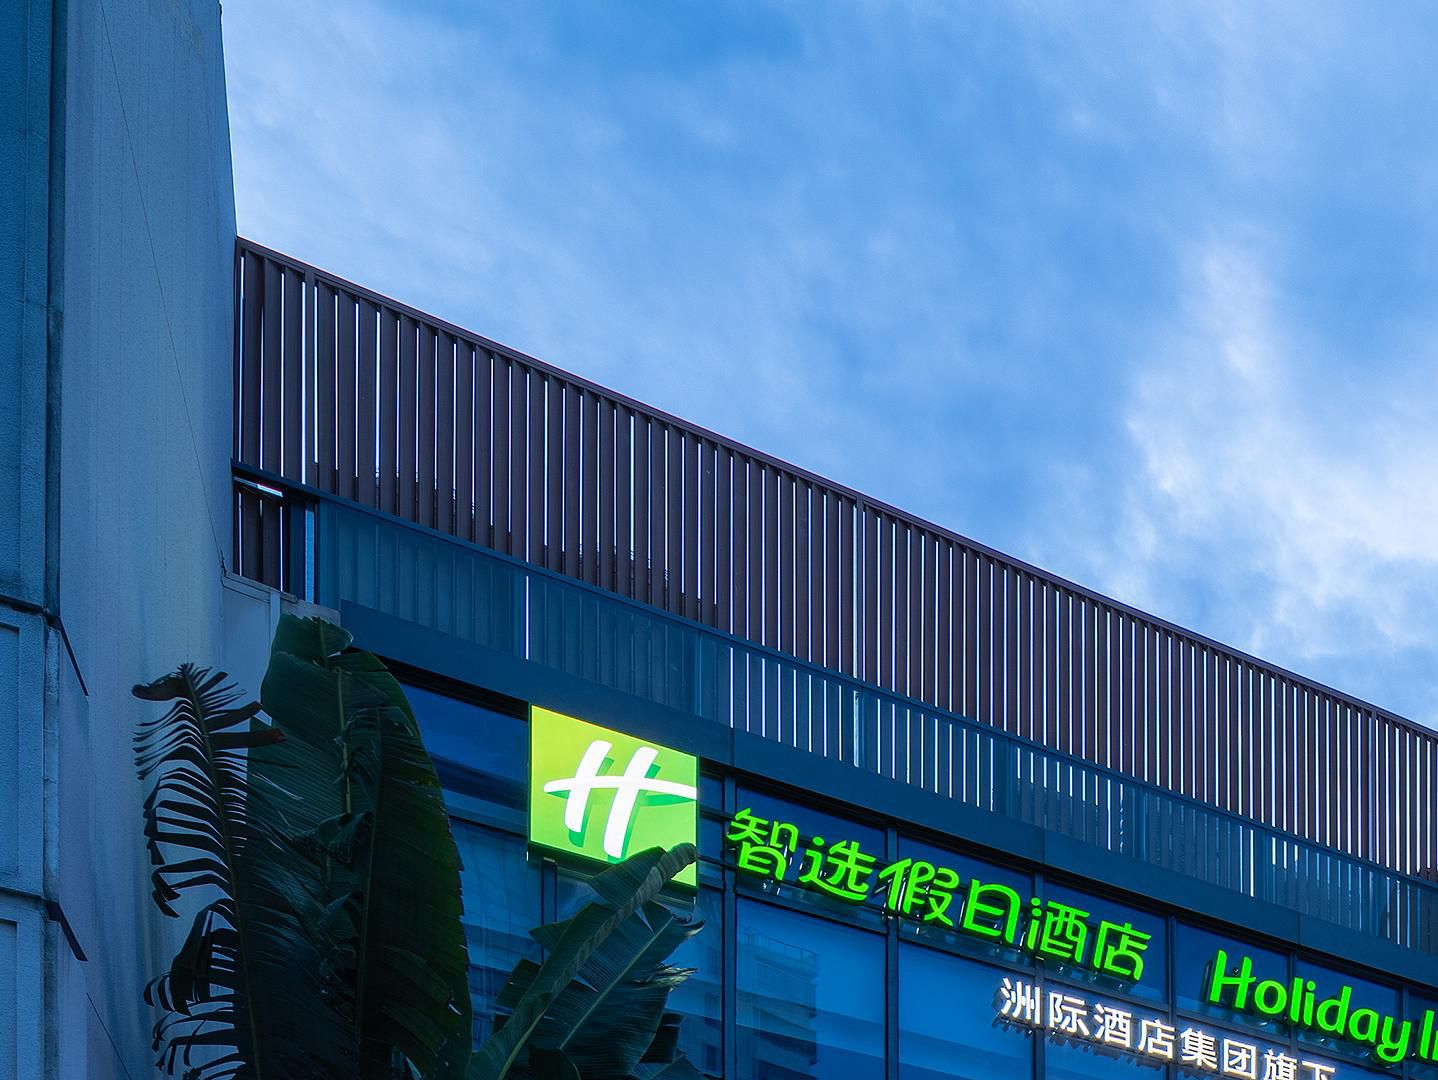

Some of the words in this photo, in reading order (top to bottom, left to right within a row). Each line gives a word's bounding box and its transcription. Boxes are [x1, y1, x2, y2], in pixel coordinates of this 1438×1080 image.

[725, 807, 1152, 981] 智选假日酒店
[1208, 948, 1412, 1064] Holiday
